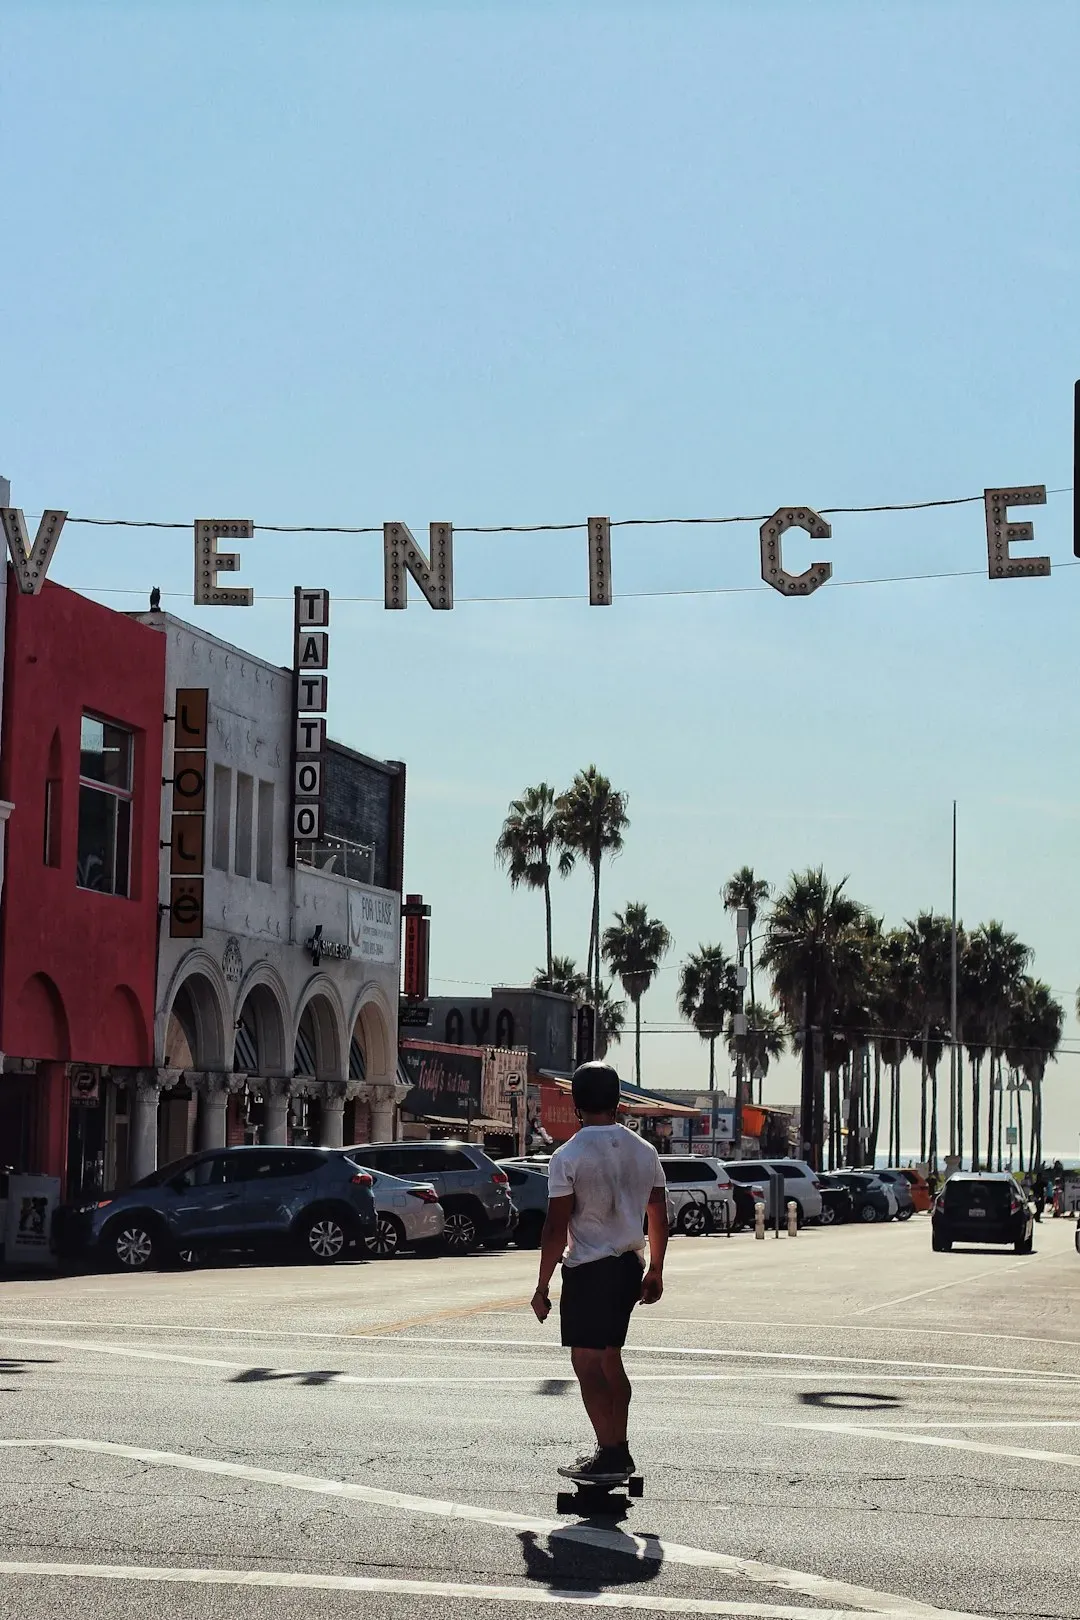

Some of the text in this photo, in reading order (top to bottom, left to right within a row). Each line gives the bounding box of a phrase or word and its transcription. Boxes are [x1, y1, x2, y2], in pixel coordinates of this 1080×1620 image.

[0, 485, 1051, 609] VENICE
[297, 594, 320, 834] TATTOO
[362, 897, 392, 925] FOR LEASE
[445, 1007, 514, 1049] AYA
